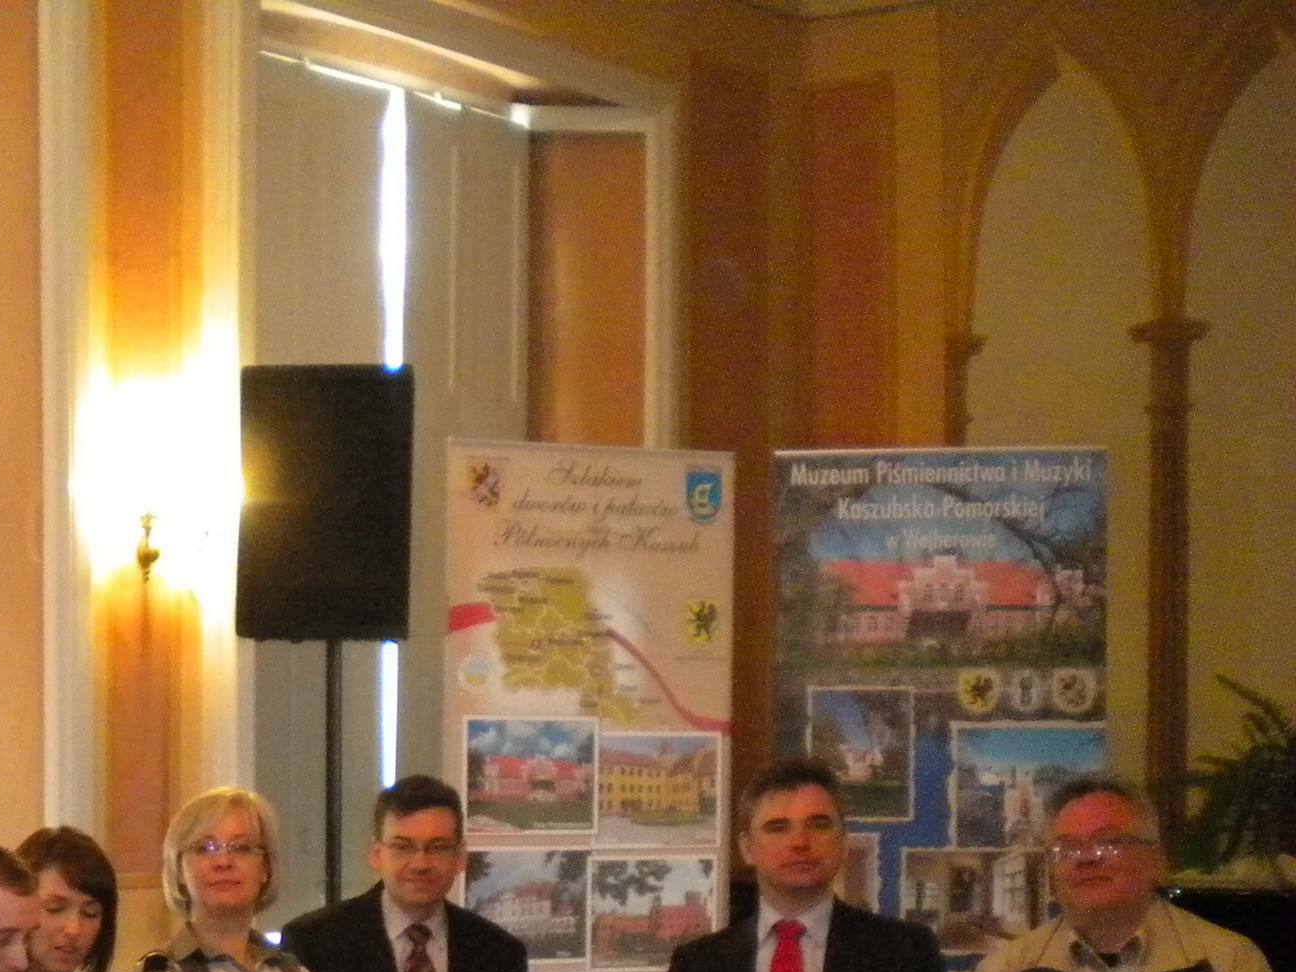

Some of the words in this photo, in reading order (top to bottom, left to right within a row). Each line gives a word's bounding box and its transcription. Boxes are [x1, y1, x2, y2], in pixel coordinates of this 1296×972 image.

[790, 463, 870, 485] Muzeum
[876, 460, 1004, 484] Piśmiennictwa
[1024, 458, 1092, 487] Muzyki
[837, 494, 1046, 524] Kaszubsko-Pomorskiej
